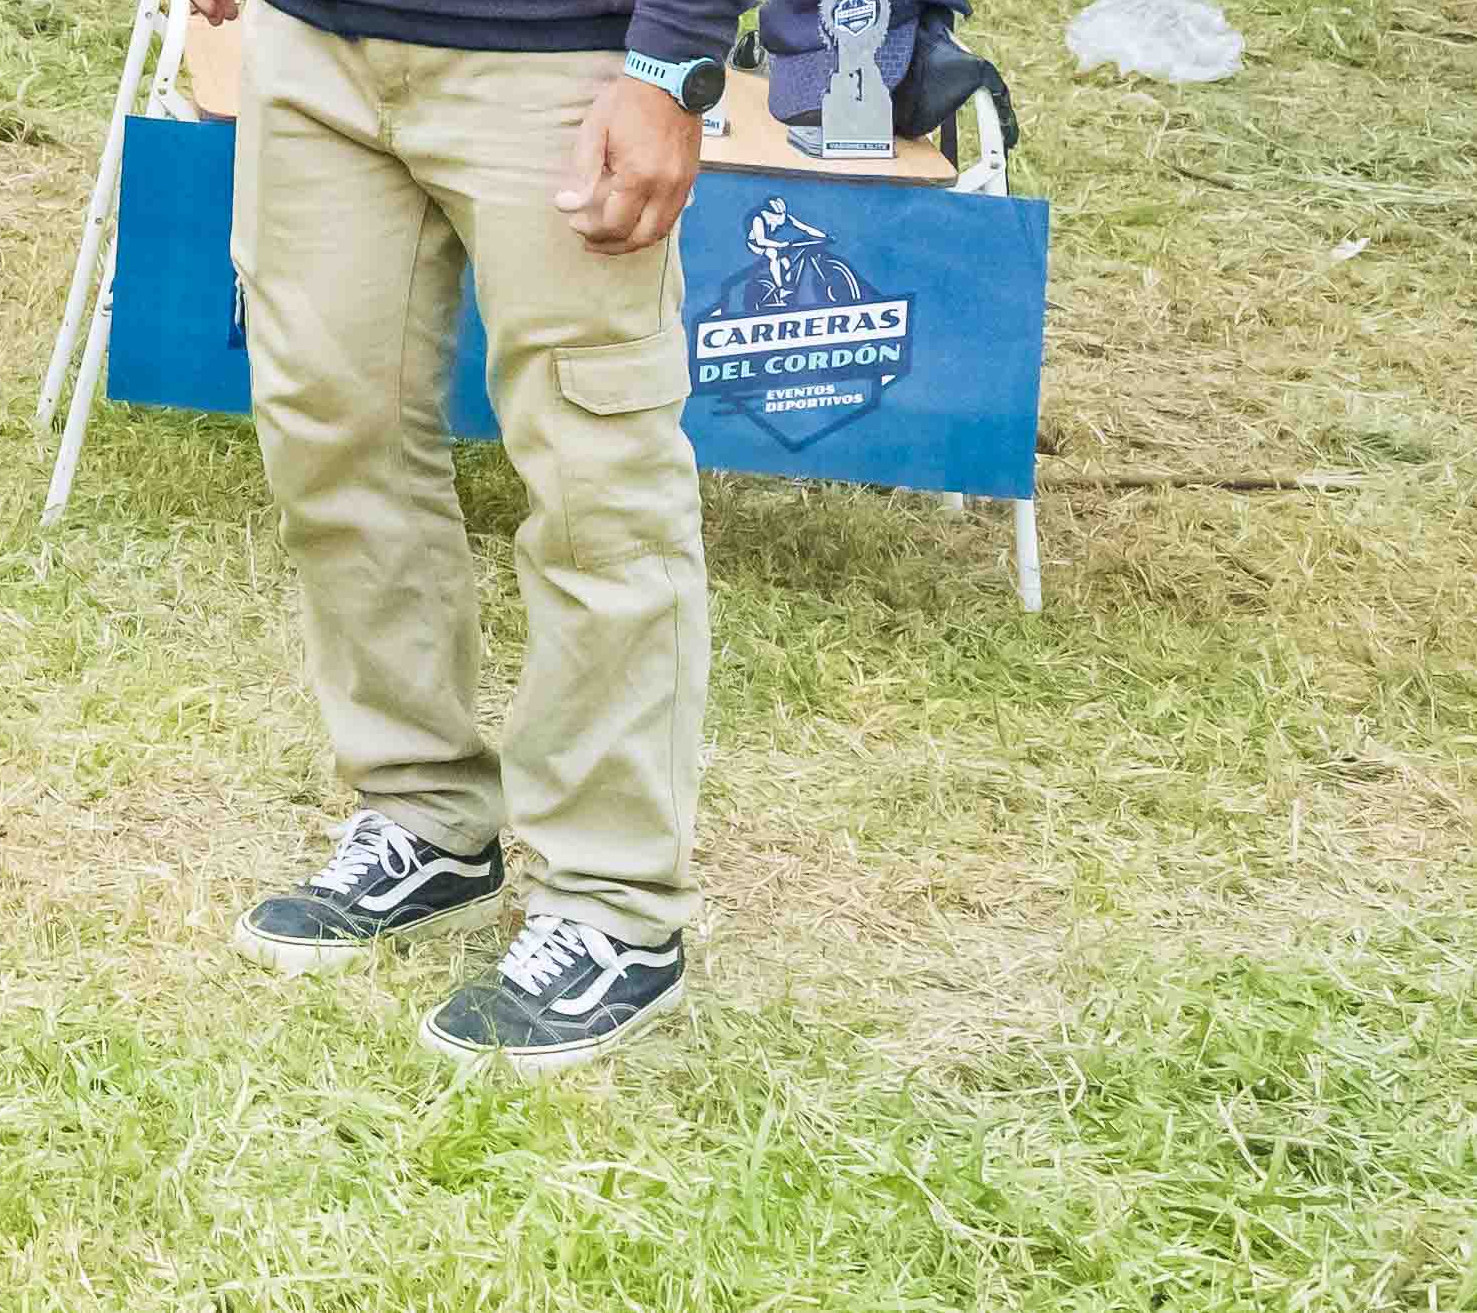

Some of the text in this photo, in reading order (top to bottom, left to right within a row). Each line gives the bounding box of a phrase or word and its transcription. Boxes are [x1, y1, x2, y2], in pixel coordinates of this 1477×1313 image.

[703, 309, 901, 348] CARRERAS
[700, 343, 901, 383] DEL CORDÓN
[766, 393, 864, 413] DEPORTIVOS
[767, 384, 835, 400] EVENTOS
